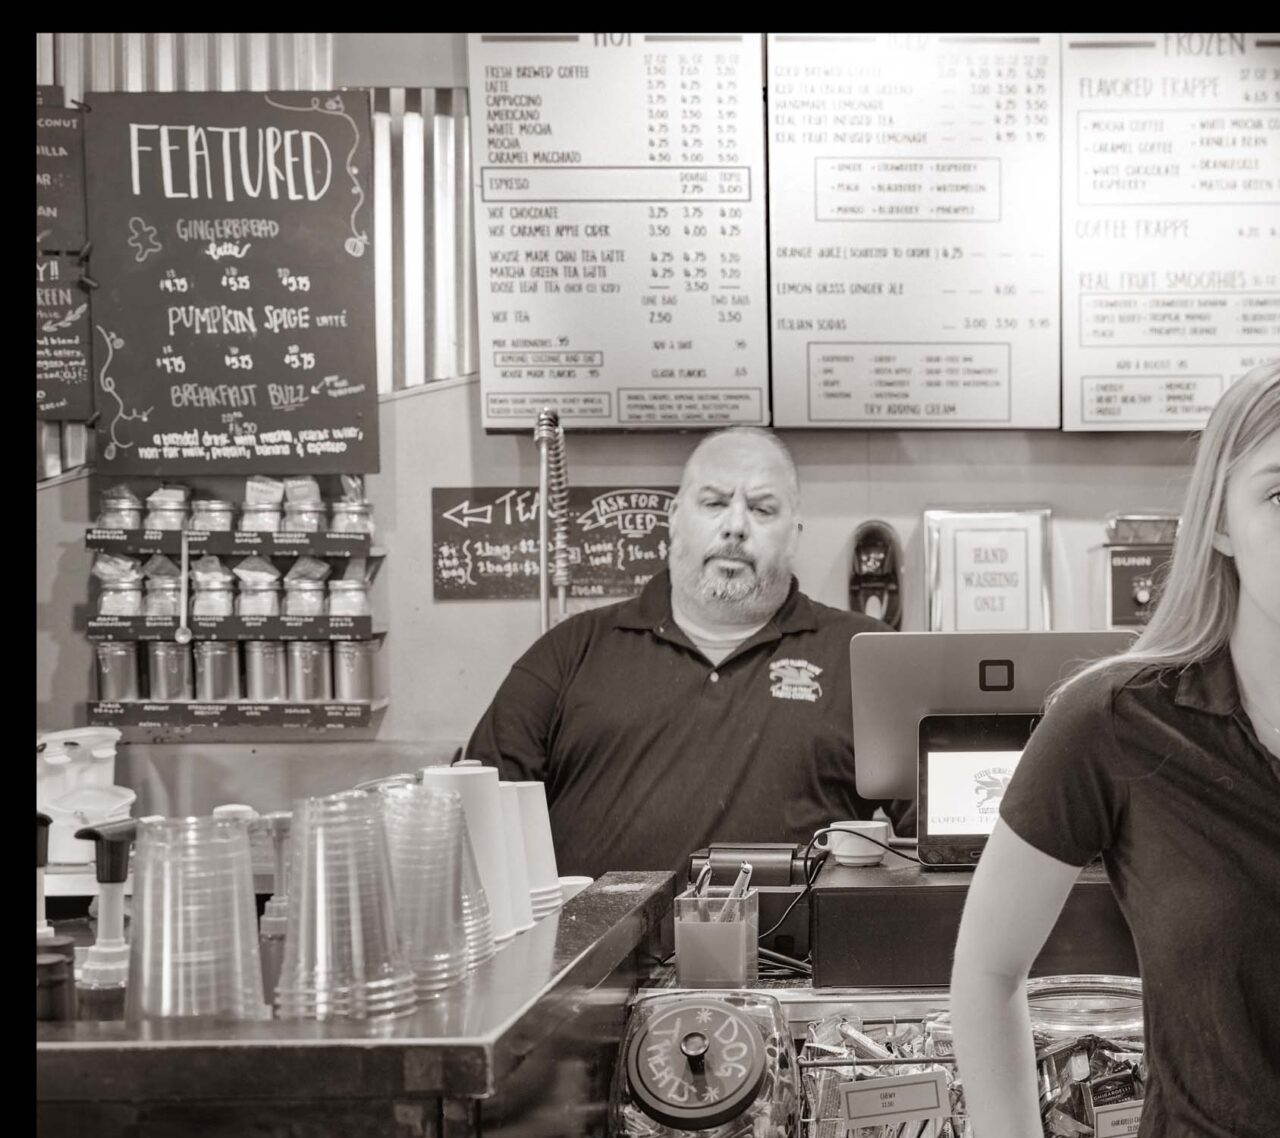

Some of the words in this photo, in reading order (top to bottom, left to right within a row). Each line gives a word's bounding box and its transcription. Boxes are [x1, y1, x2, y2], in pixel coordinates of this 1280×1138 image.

[557, 65, 590, 79] COFFEE
[1079, 77, 1153, 100] FLAVORED
[1161, 77, 1220, 100] FRAPPE
[487, 108, 541, 121] AMERICANO
[519, 122, 552, 136] MOCHA
[129, 122, 332, 202] FEATURED
[509, 206, 559, 219] CHOCOLATE
[176, 218, 280, 242] GINGERBREAD
[1075, 219, 1126, 239] COFFEE
[1135, 219, 1190, 240] FRAPPE
[777, 284, 813, 296] LEMON
[849, 284, 884, 296] GINGER
[1078, 271, 1110, 291] REAL
[1120, 271, 1157, 291] FRUIT
[1165, 271, 1247, 291] SMOOTHIES
[168, 305, 257, 335] PUMPKIN
[170, 383, 257, 407] BREAKFAST
[266, 383, 310, 407] BUZZ
[863, 404, 881, 416] TRY
[886, 404, 922, 416] ADDING
[925, 404, 957, 416] CREAM
[600, 496, 629, 515] ASK
[630, 494, 661, 509] FOR
[618, 513, 658, 532] ICED
[973, 547, 1009, 564] HAND
[1111, 556, 1152, 567] BUNN
[962, 571, 1020, 588] WASHING
[974, 595, 1006, 612] ONLY
[714, 1015, 748, 1079] DOG
[647, 1017, 698, 1102] TREATS
[880, 1092, 896, 1101] CHEWY
